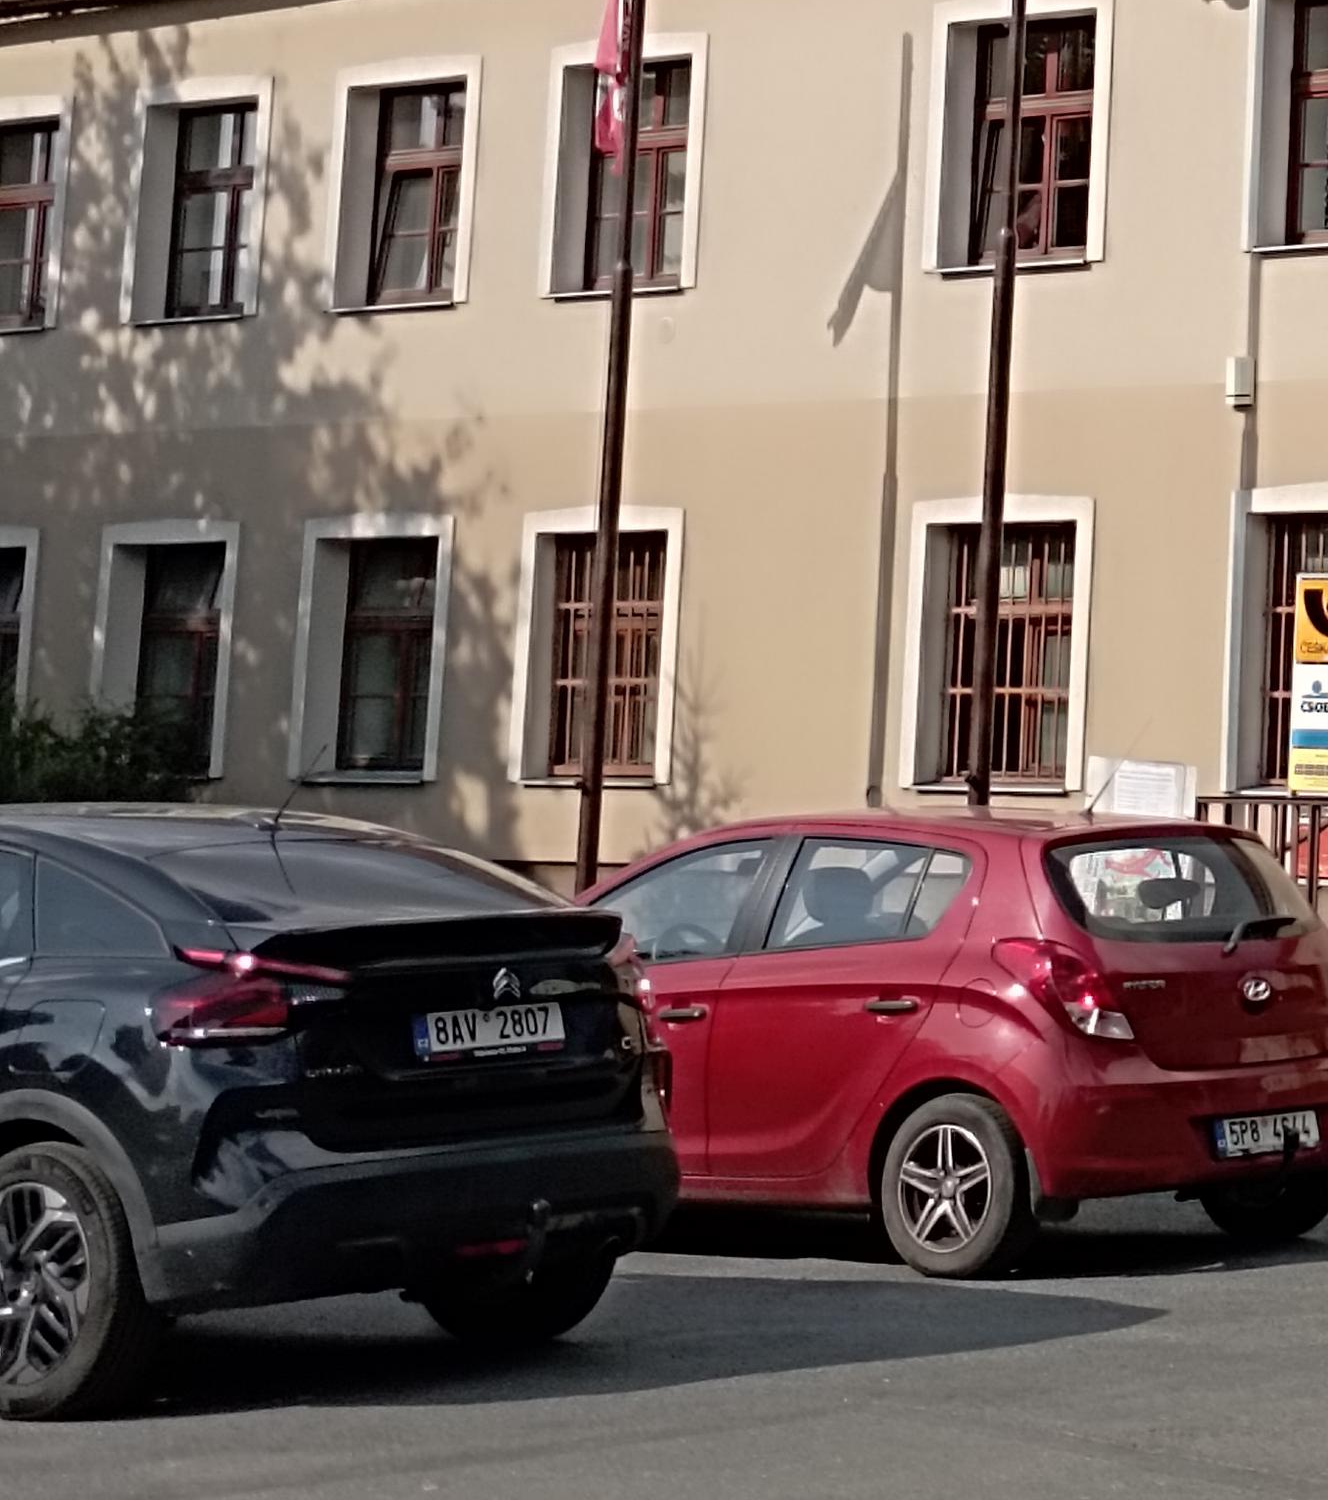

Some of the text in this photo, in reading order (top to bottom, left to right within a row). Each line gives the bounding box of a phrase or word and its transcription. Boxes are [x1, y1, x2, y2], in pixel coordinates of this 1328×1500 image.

[434, 1006, 549, 1045] 8AV 2807
[1228, 1119, 1260, 1146] 5P8
